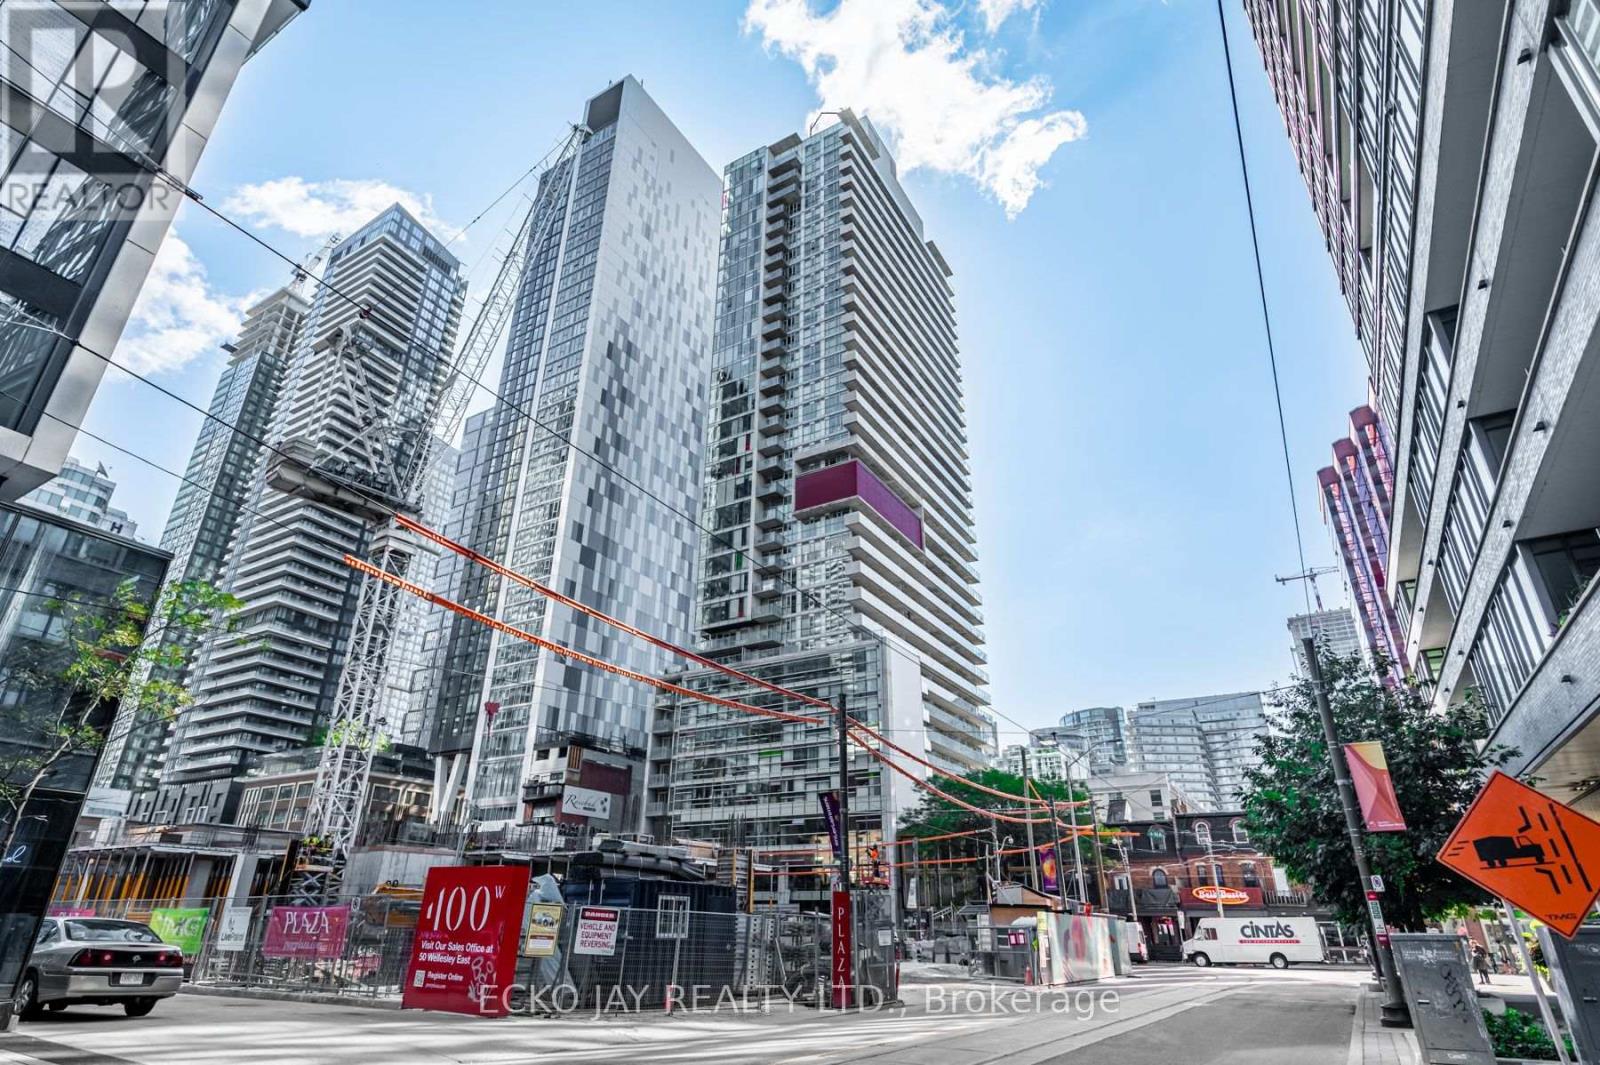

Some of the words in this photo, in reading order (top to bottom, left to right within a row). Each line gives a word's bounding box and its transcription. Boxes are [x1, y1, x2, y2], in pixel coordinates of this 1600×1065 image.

[283, 911, 329, 934] PLAZA
[580, 922, 603, 931] VEHICLE
[604, 924, 616, 932] AND
[581, 931, 612, 940] EQUIPMENT
[421, 940, 435, 949] Visit
[435, 941, 446, 950] Our
[447, 942, 464, 952] Sales
[465, 943, 485, 953] Office
[485, 945, 494, 953] at
[580, 939, 610, 949] REVERSING
[837, 906, 846, 989] PLAZA
[418, 952, 427, 961] 50
[427, 952, 456, 966] Wellesley
[456, 955, 471, 965] East
